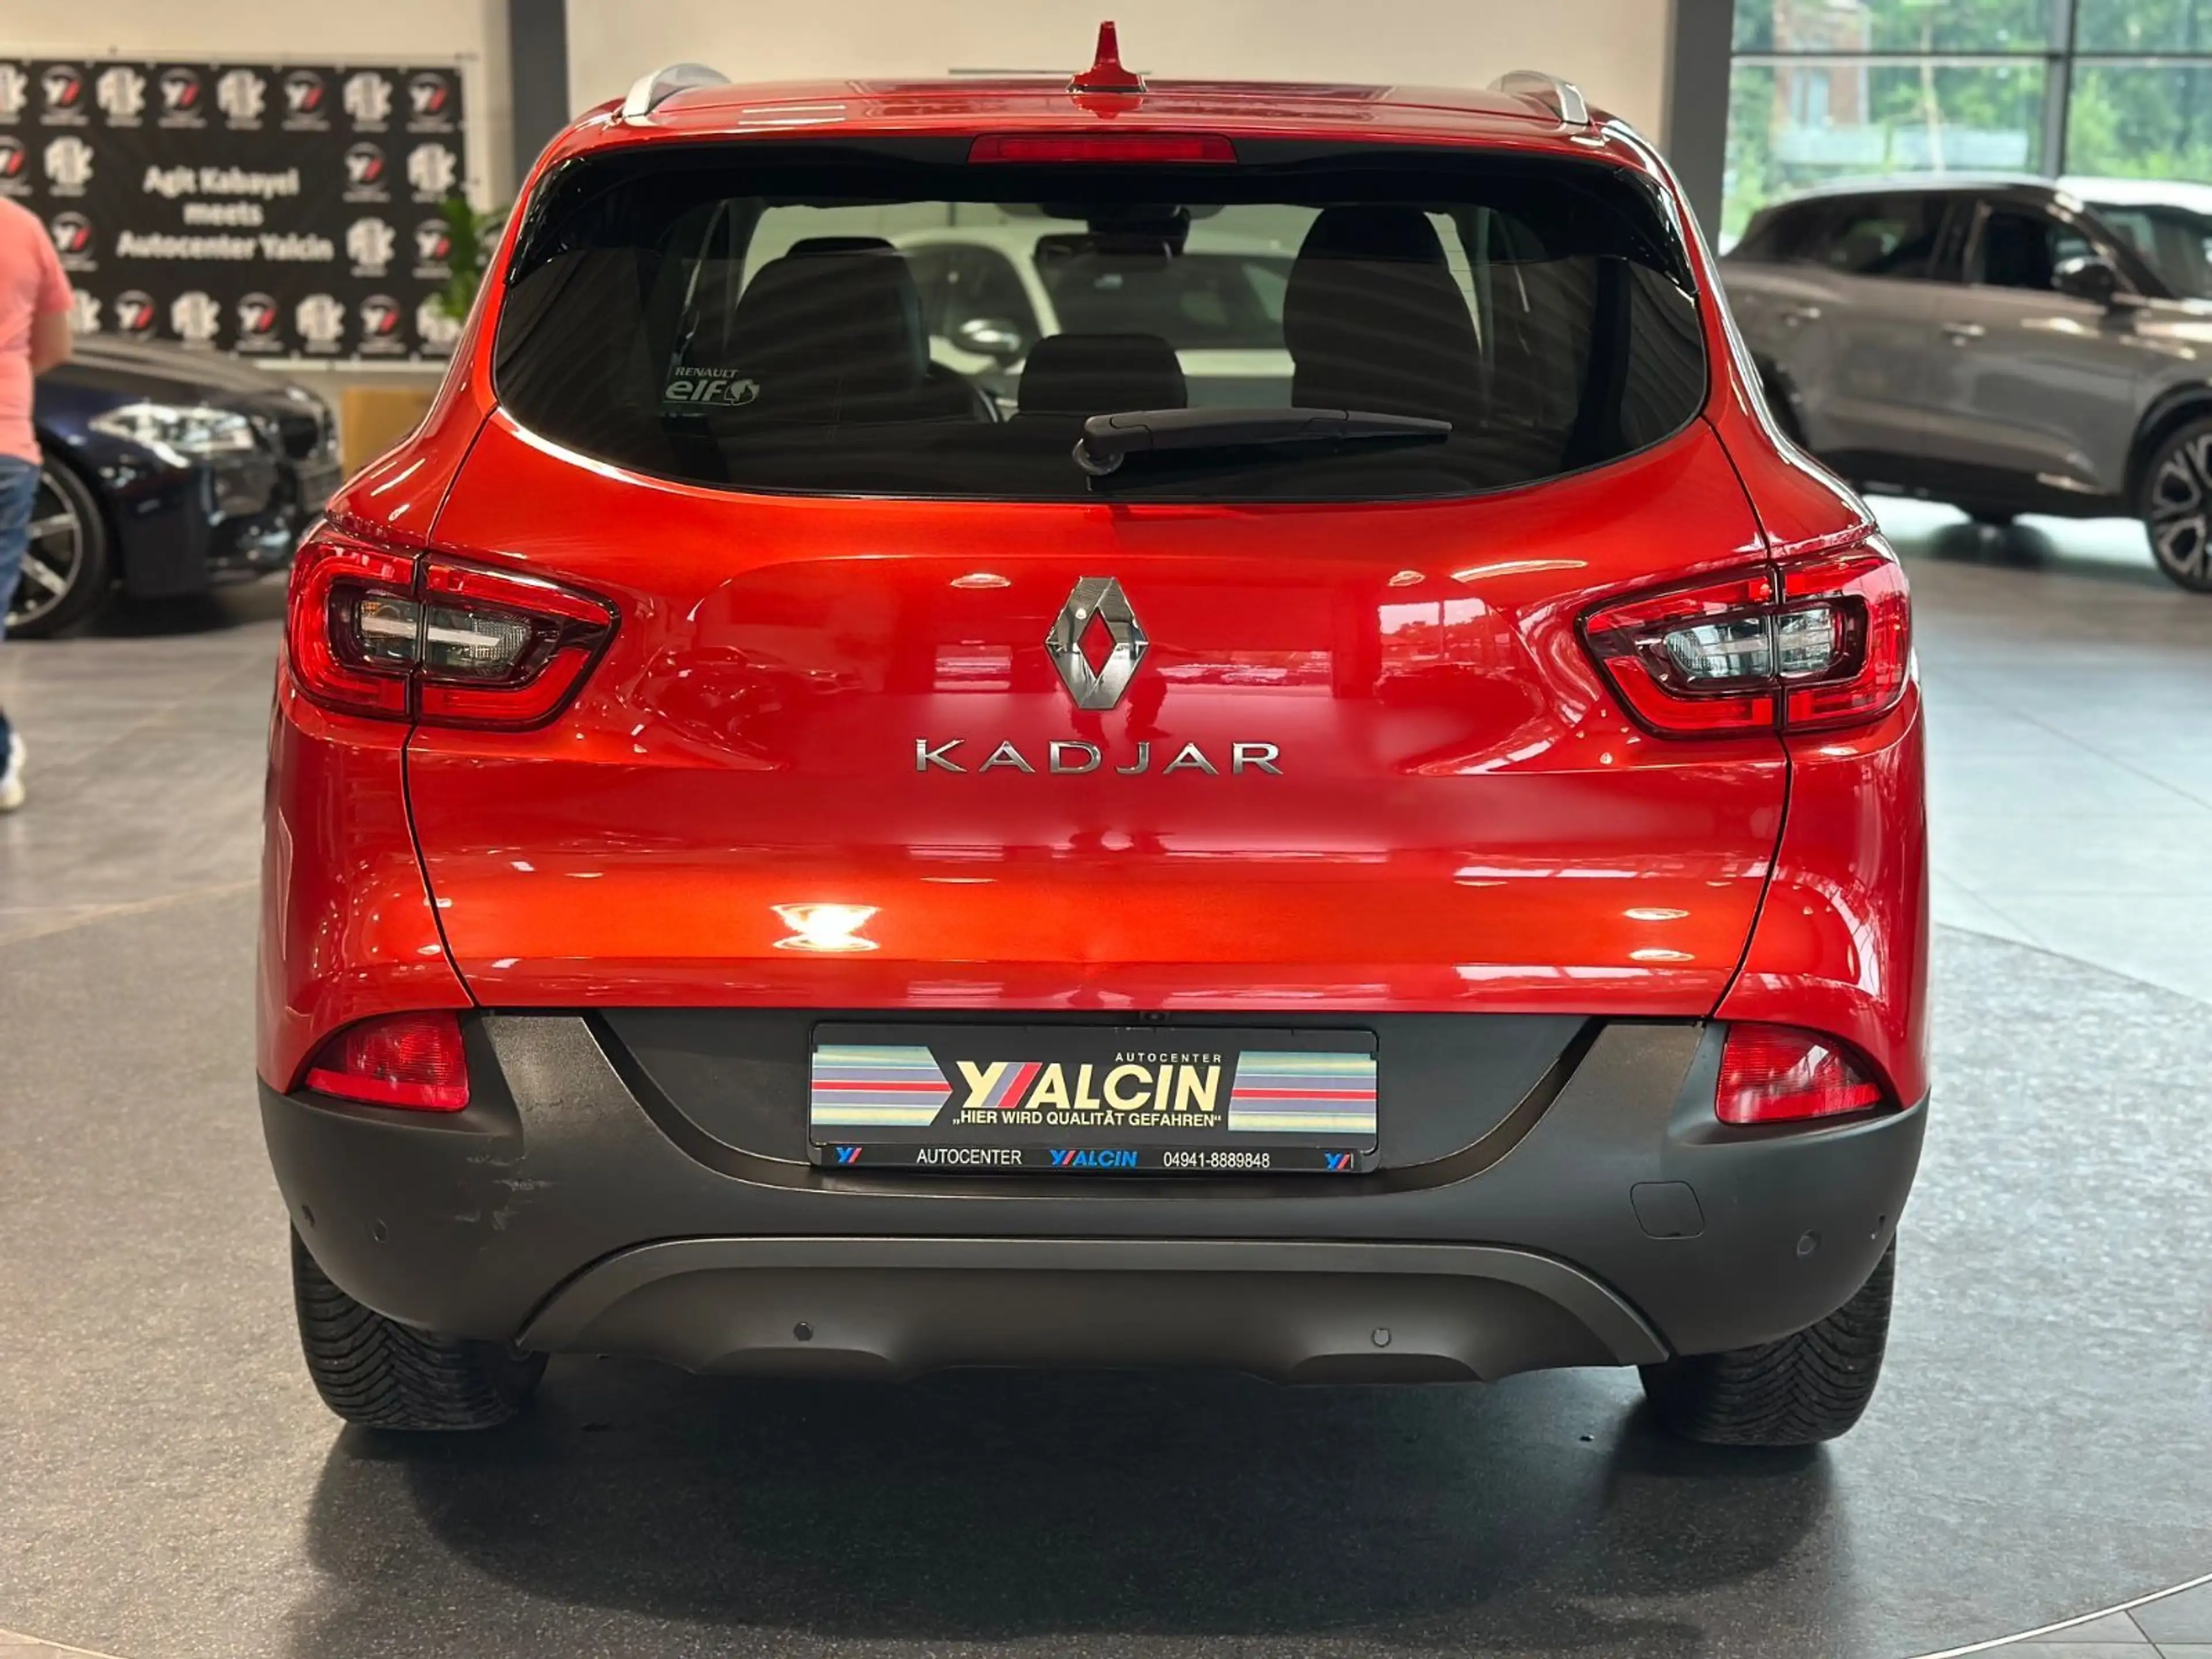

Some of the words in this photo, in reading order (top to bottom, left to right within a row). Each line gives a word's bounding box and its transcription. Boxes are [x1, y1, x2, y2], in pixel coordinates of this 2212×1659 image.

[143, 166, 198, 199] Agit
[183, 200, 264, 226] meets
[117, 230, 257, 260] Autocenter
[259, 233, 335, 262] Yalcin
[675, 366, 738, 378] RENAULT
[916, 738, 1283, 775] KADJAR
[1115, 1052, 1222, 1063] AUTOCENTER
[1000, 1111, 1043, 1124] WIRD
[1046, 1110, 1125, 1126] QUALITÄT
[916, 1148, 1022, 1165] AUTOCENTER
[1162, 1152, 1271, 1168] 04941-8889848
